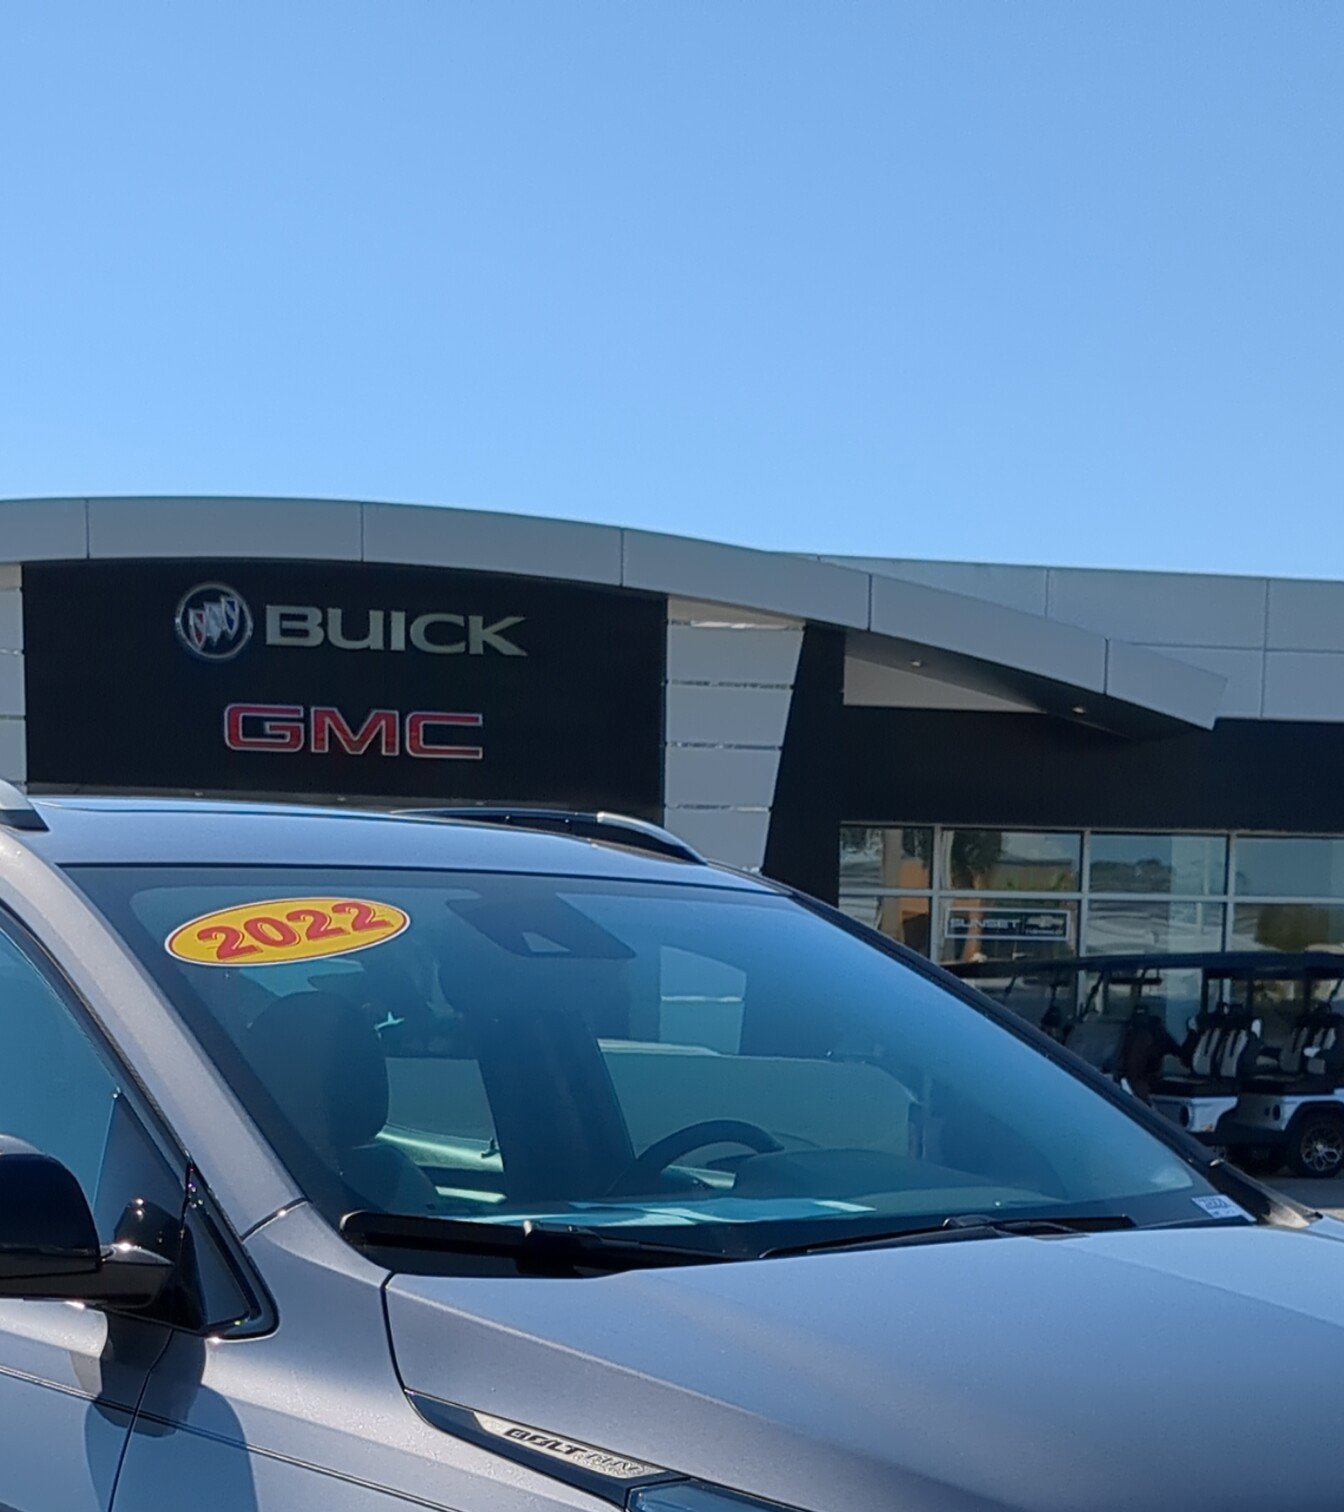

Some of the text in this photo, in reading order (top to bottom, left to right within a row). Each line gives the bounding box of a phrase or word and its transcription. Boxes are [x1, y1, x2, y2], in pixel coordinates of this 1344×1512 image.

[265, 605, 527, 657] BUICK
[224, 704, 484, 760] GMC
[197, 900, 391, 960] 2022
[504, 1428, 587, 1454] BOLT
